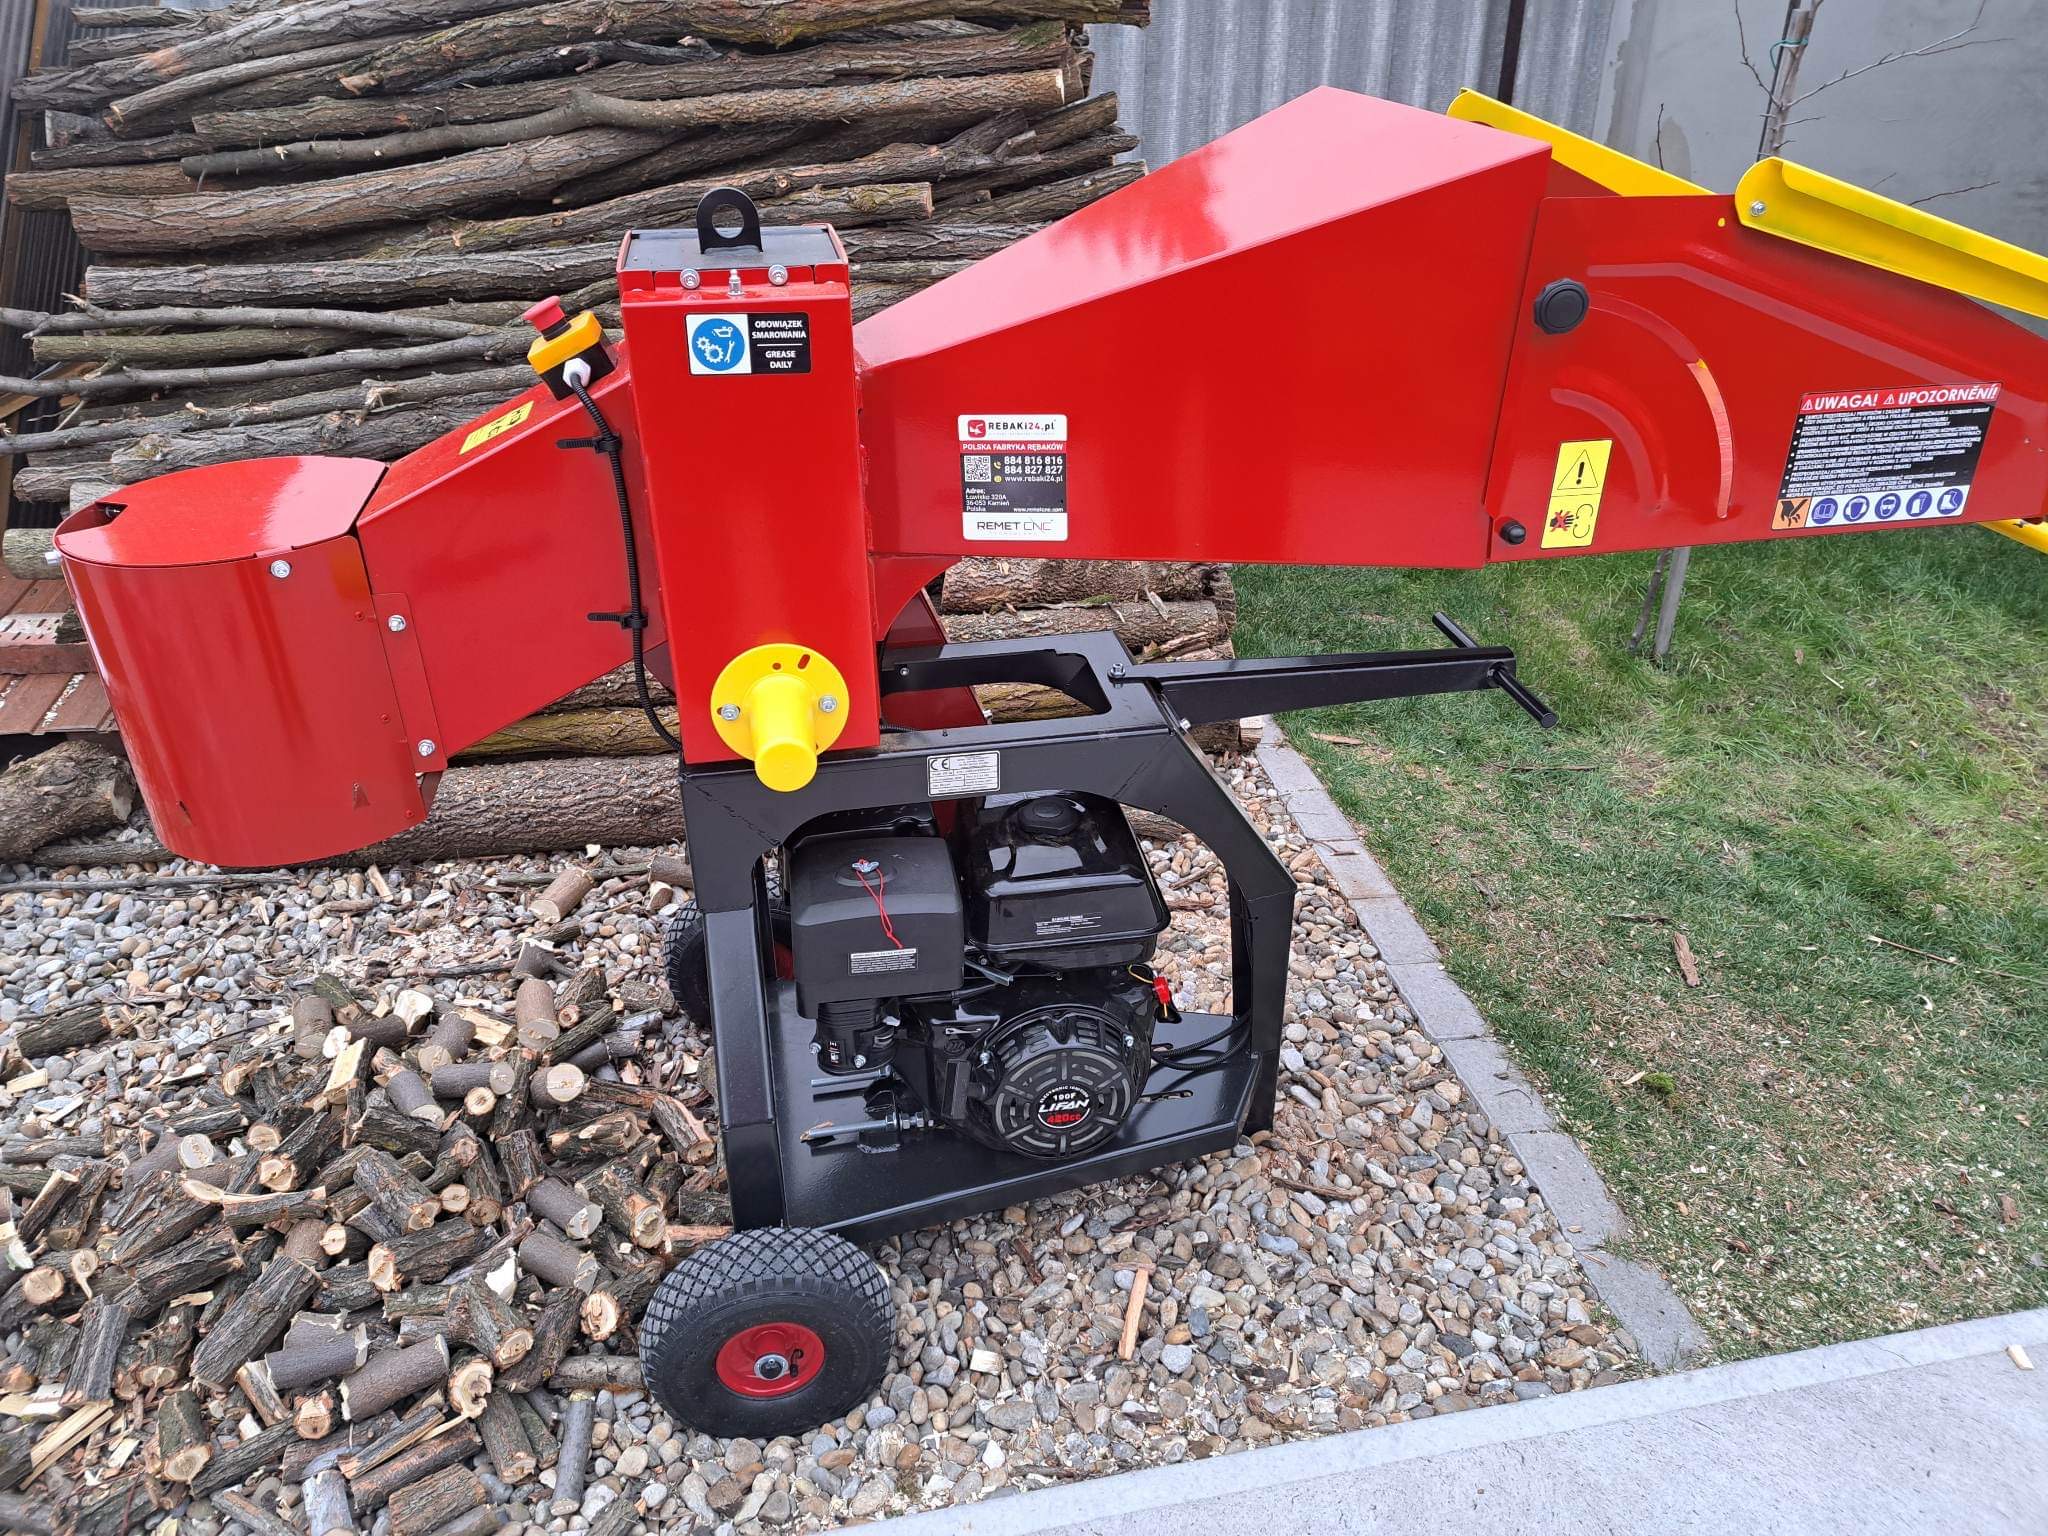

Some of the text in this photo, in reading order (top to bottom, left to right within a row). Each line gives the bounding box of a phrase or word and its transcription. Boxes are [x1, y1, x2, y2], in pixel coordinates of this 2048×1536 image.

[754, 320, 803, 329] OBOWIĄZEK
[752, 331, 806, 339] SMAROWANIA
[765, 350, 796, 358] GREASE
[769, 361, 793, 369] DAILY
[1814, 384, 1998, 410] UWAGA! UPOZORNĚNÍ!
[1027, 442, 1064, 451] RĘBAKÓW
[1004, 456, 1063, 465] 884 816 816
[1004, 465, 1063, 474] 884 827 827
[1004, 475, 1064, 483] www.rebaki24.pl
[977, 521, 1052, 531] REMET CNC
[1038, 1099, 1090, 1113] LIFAN
[1046, 1113, 1081, 1123] 420cc
